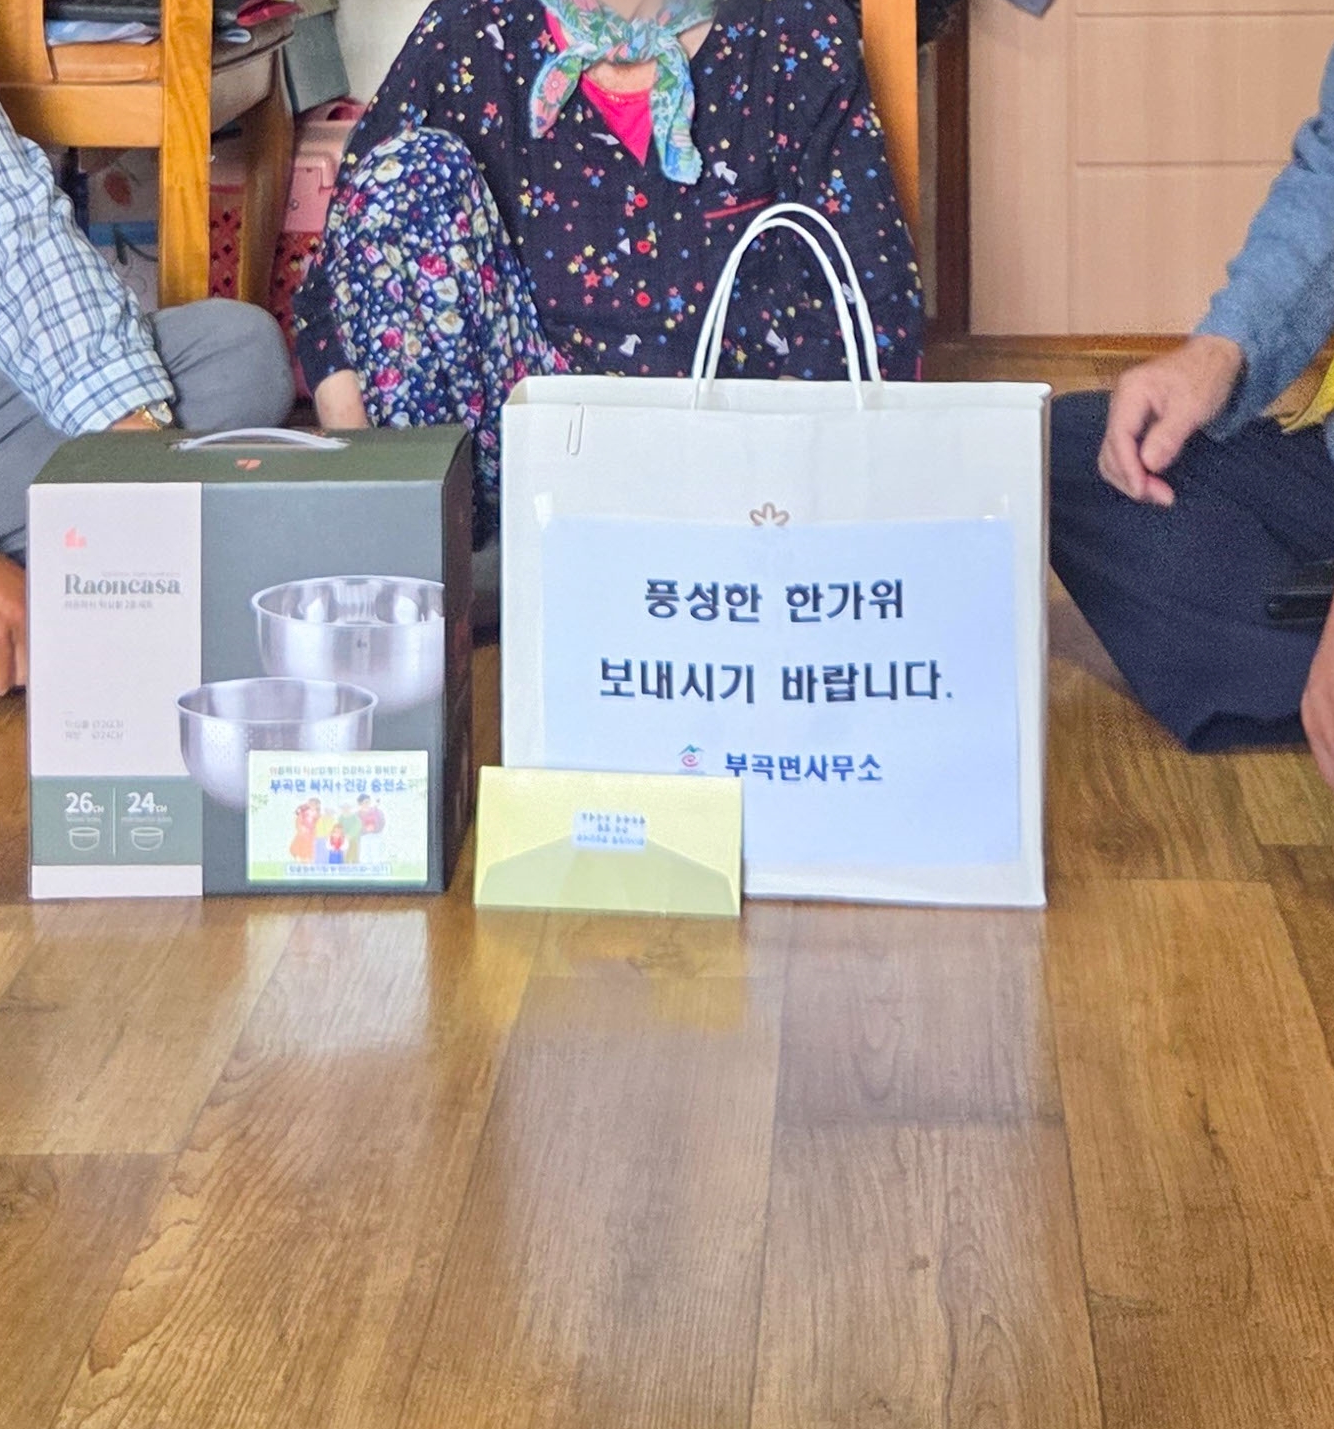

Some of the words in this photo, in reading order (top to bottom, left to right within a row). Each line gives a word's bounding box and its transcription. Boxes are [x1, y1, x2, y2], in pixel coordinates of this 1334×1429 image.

[64, 573, 181, 595] Raoncasa
[644, 578, 764, 623] 풍성한
[785, 578, 905, 623] 한가위
[599, 657, 755, 704] 보내시기
[781, 658, 953, 704] 바랍니다.
[724, 752, 884, 782] 부곡면사무소
[270, 778, 307, 794] 부곡면
